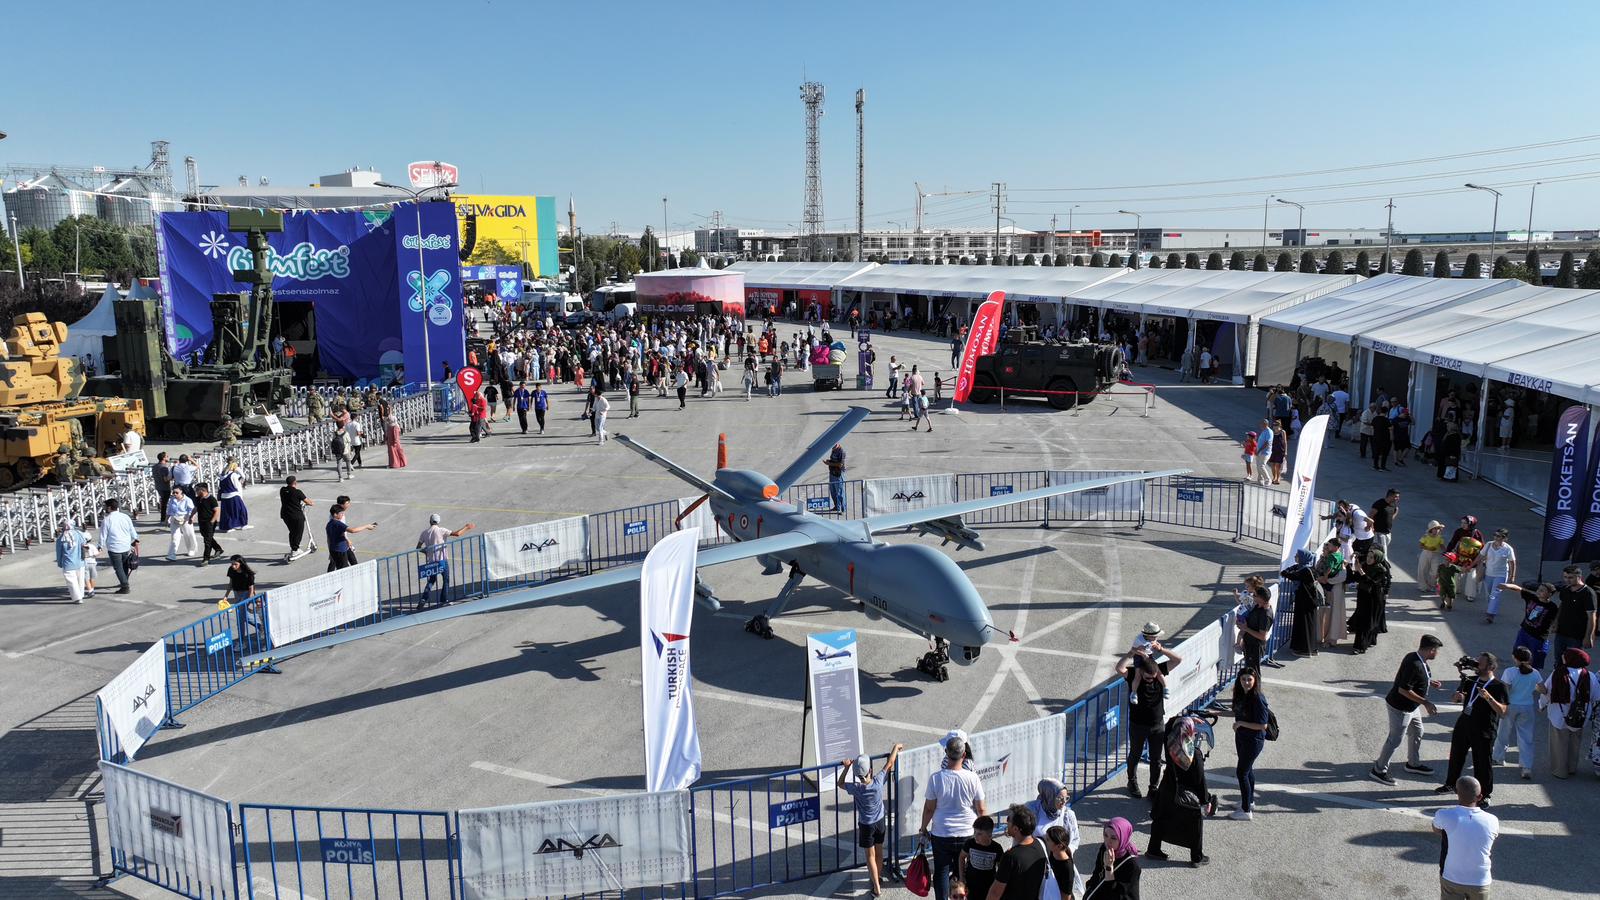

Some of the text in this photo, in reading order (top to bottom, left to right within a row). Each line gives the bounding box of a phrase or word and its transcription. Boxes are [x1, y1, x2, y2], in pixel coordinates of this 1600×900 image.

[495, 205, 526, 217] GIDA
[965, 315, 988, 375] TÜMOSAN
[1375, 341, 1398, 354] BAYKAR
[1434, 355, 1463, 371] BAYKAR
[463, 371, 475, 386] S
[1514, 373, 1553, 393] BAYKAR
[1557, 423, 1578, 511] ROKETSAN
[420, 565, 444, 577] POLİS
[209, 637, 230, 654] POLİS
[667, 647, 677, 700] TURKISH
[781, 801, 809, 811] KONYA
[776, 808, 815, 827] POLİS
[326, 848, 373, 863] POLİS
